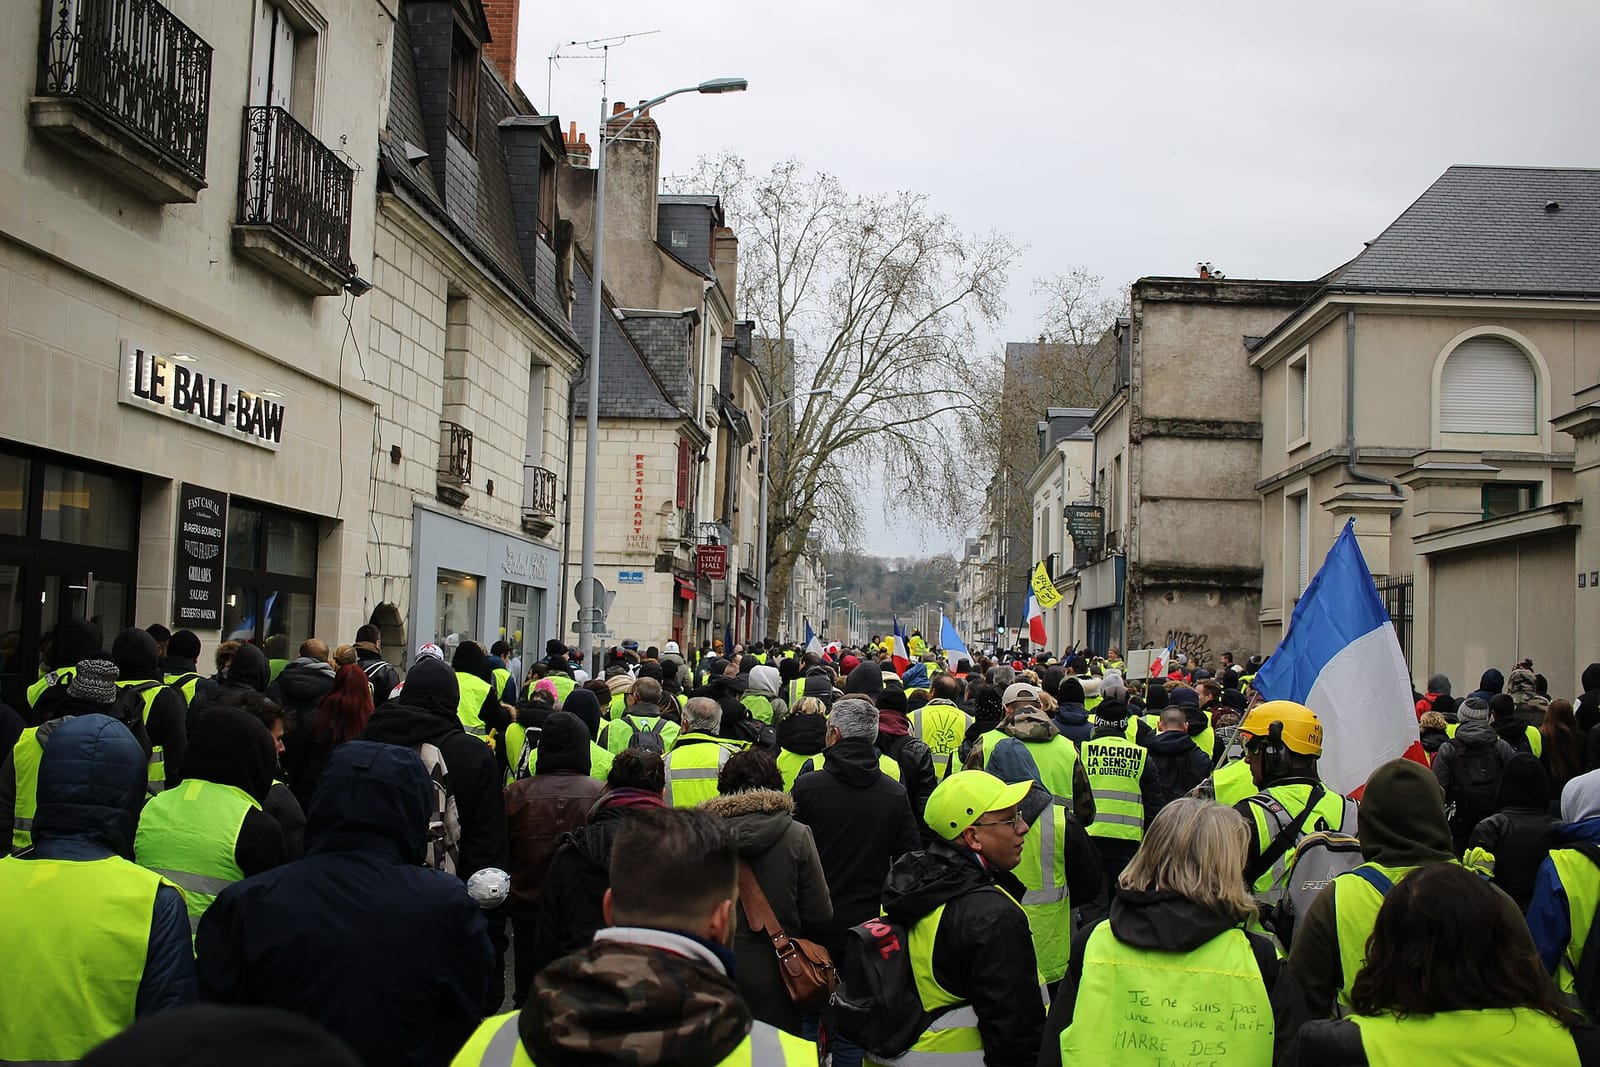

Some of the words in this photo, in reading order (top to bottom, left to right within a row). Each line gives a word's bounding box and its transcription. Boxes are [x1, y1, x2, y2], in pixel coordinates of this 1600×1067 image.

[134, 349, 167, 404] LE
[173, 364, 286, 443] BALI-BAW
[634, 454, 644, 534] RESTAURANT
[187, 497, 201, 510] FAST
[201, 497, 220, 517] CASUAL
[183, 522, 201, 535] BURGERS
[201, 526, 222, 538] GOURMETS
[184, 539, 199, 558] FRITES
[188, 565, 212, 583] GRILLADES
[189, 588, 209, 601] SALADES
[181, 607, 201, 619] DESSERTS
[201, 608, 217, 620] MAISON
[1088, 744, 1142, 761] MACRON
[1087, 757, 1099, 767] LA
[1087, 767, 1097, 776] LA
[1099, 768, 1133, 778] QUENELLE
[1128, 990, 1153, 1007] Je
[1161, 998, 1178, 1008] ne
[1191, 1002, 1221, 1013] suis
[1230, 1003, 1258, 1021] pas
[1125, 1011, 1155, 1025] une
[1161, 1017, 1207, 1030] vache
[1114, 1030, 1173, 1052] MARRE
[1188, 1040, 1227, 1056] DES
